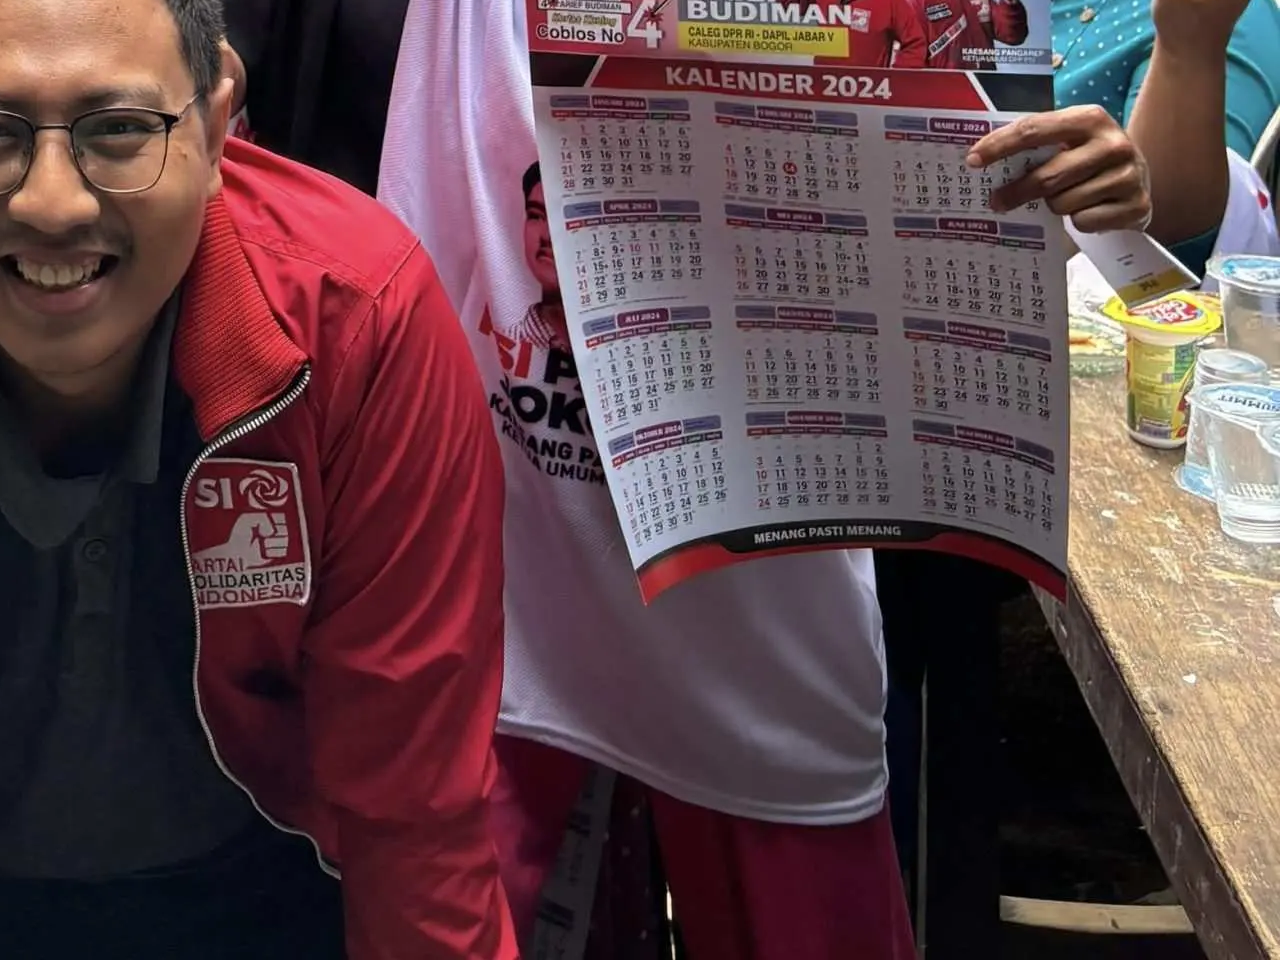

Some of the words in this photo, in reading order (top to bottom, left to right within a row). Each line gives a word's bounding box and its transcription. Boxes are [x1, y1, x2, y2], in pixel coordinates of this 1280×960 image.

[558, 0, 584, 9] ARIEF
[585, 1, 622, 11] BUDIMAN
[688, 0, 852, 25] BUDIMAN
[537, 24, 596, 42] Coblos
[603, 26, 625, 44] No
[627, 0, 662, 49] 4
[688, 26, 721, 38] CALEG
[722, 27, 742, 39] DPR
[744, 28, 754, 39] RI
[762, 28, 790, 41] DAPIL
[792, 29, 825, 42] JABAR
[826, 30, 834, 42] V
[688, 38, 751, 51] KABUPATEN
[753, 40, 793, 52] BOGOR
[665, 65, 814, 94] KALENDER
[822, 74, 892, 100] 2024
[194, 477, 234, 510] SI
[754, 527, 806, 544] MENANG
[809, 525, 843, 537] PASTI
[846, 525, 902, 537] MENANG
[192, 557, 244, 574] ARTAI
[195, 567, 305, 589] OLIDARITAS
[198, 584, 304, 605] NDONESIA
